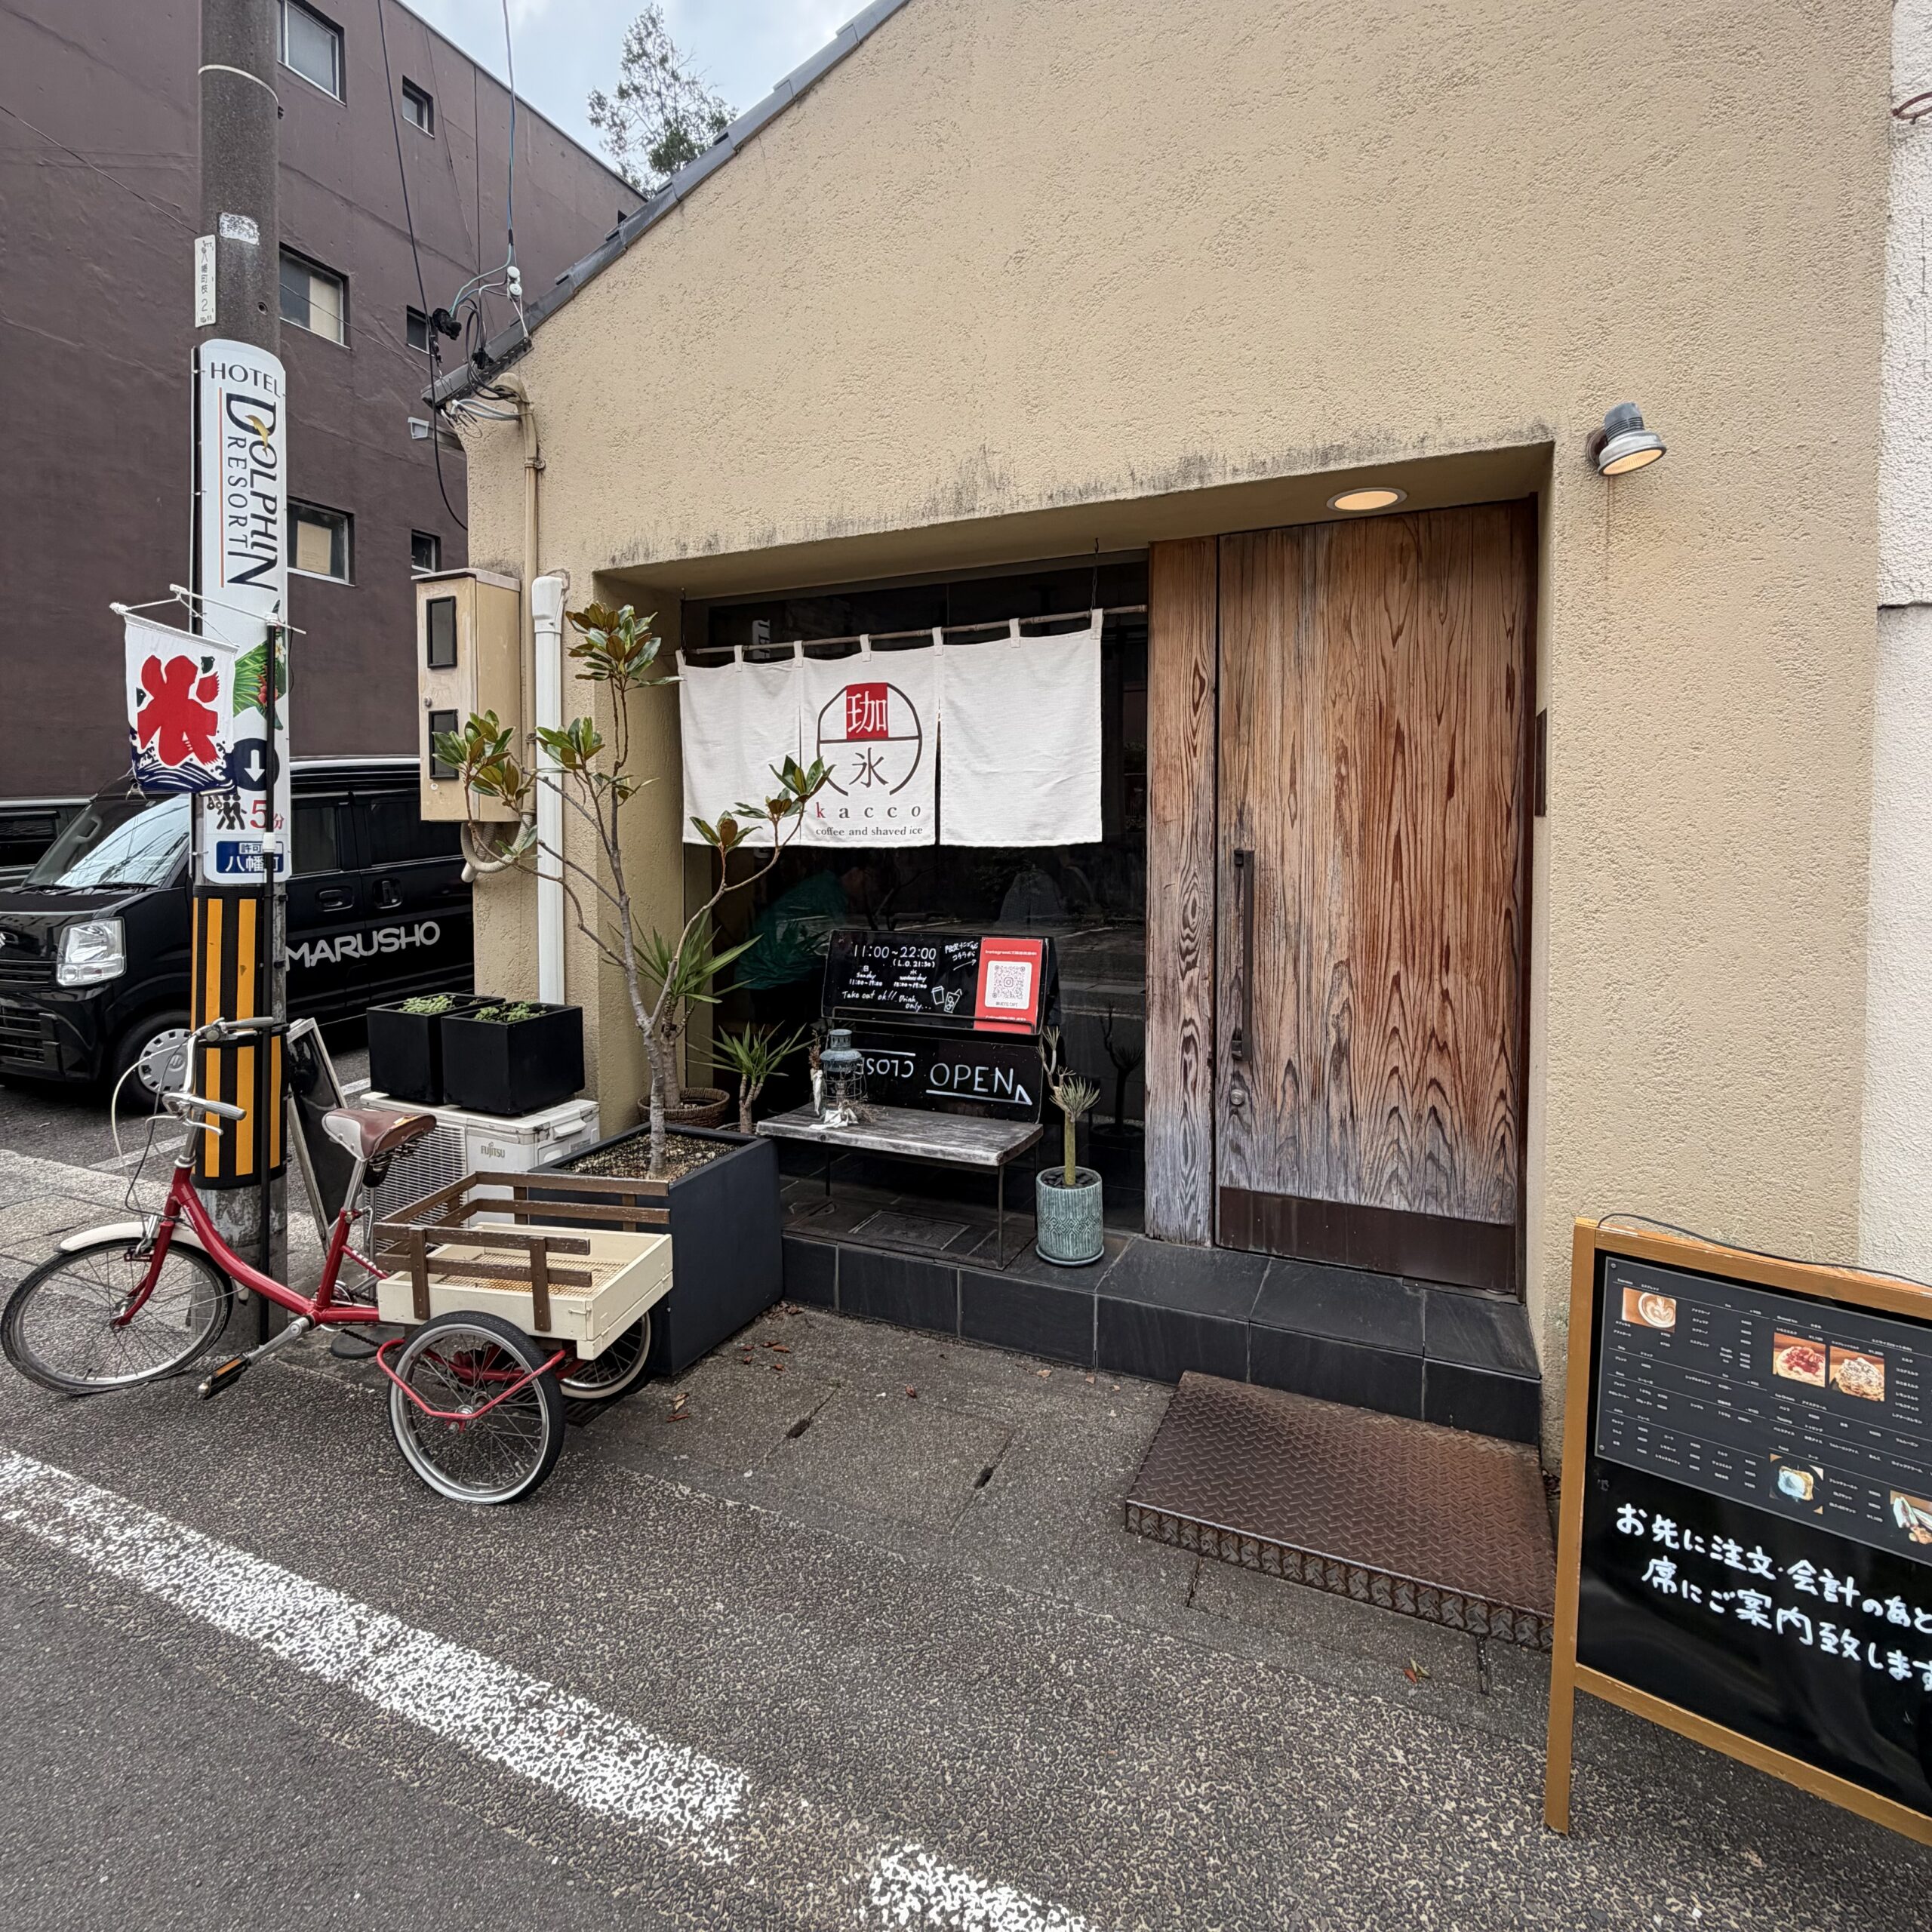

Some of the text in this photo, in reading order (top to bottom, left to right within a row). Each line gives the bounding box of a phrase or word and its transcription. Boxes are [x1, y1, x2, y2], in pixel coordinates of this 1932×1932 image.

[211, 362, 281, 398] HOTEL
[226, 392, 278, 592] DOLPHIN
[227, 436, 248, 549] RESORT
[847, 691, 888, 734] 珈
[848, 747, 889, 788] 氷
[816, 801, 921, 819] kacco
[816, 826, 923, 836] coffee and shaved ice
[285, 921, 440, 971] MARUSHO
[842, 990, 860, 998] Take
[930, 1063, 1014, 1094] OPEN
[481, 1141, 505, 1158] FUJITSU
